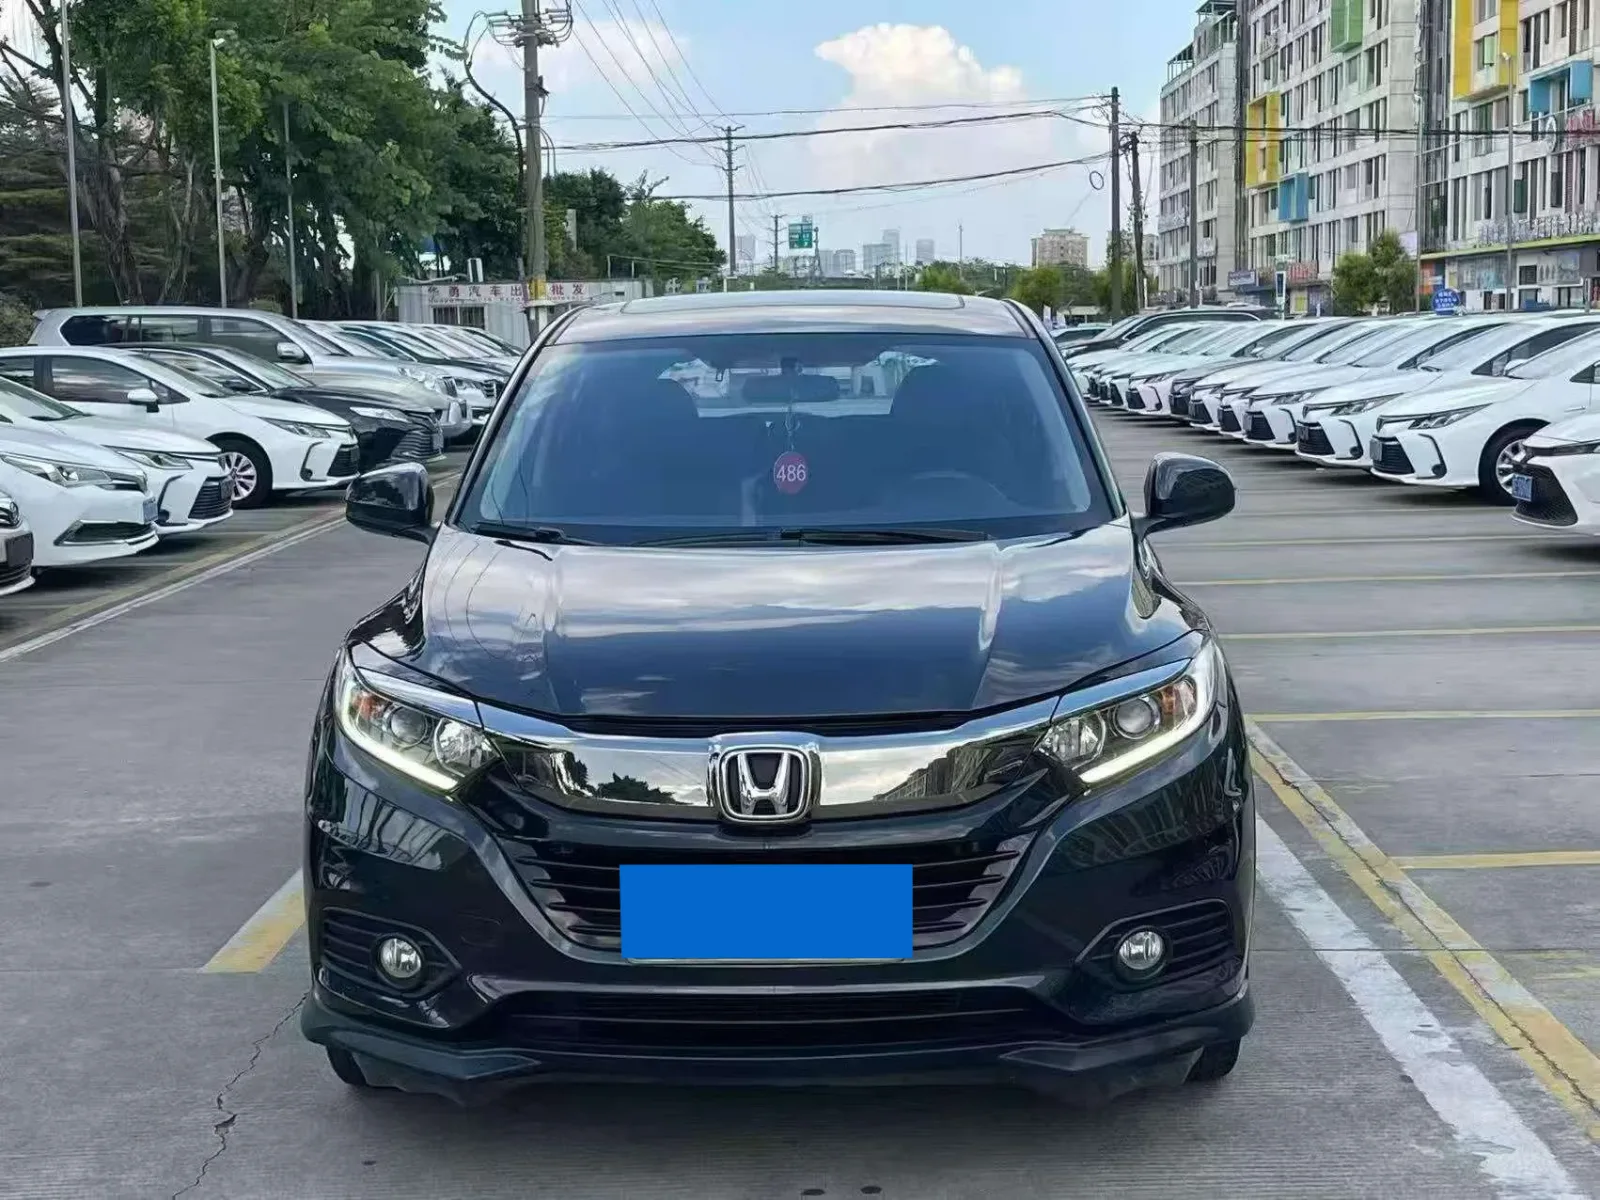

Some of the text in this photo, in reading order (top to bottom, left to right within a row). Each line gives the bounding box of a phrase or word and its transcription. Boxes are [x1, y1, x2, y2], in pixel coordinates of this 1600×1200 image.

[428, 284, 584, 298] 华勇汽车出批发
[776, 464, 806, 481] 486
